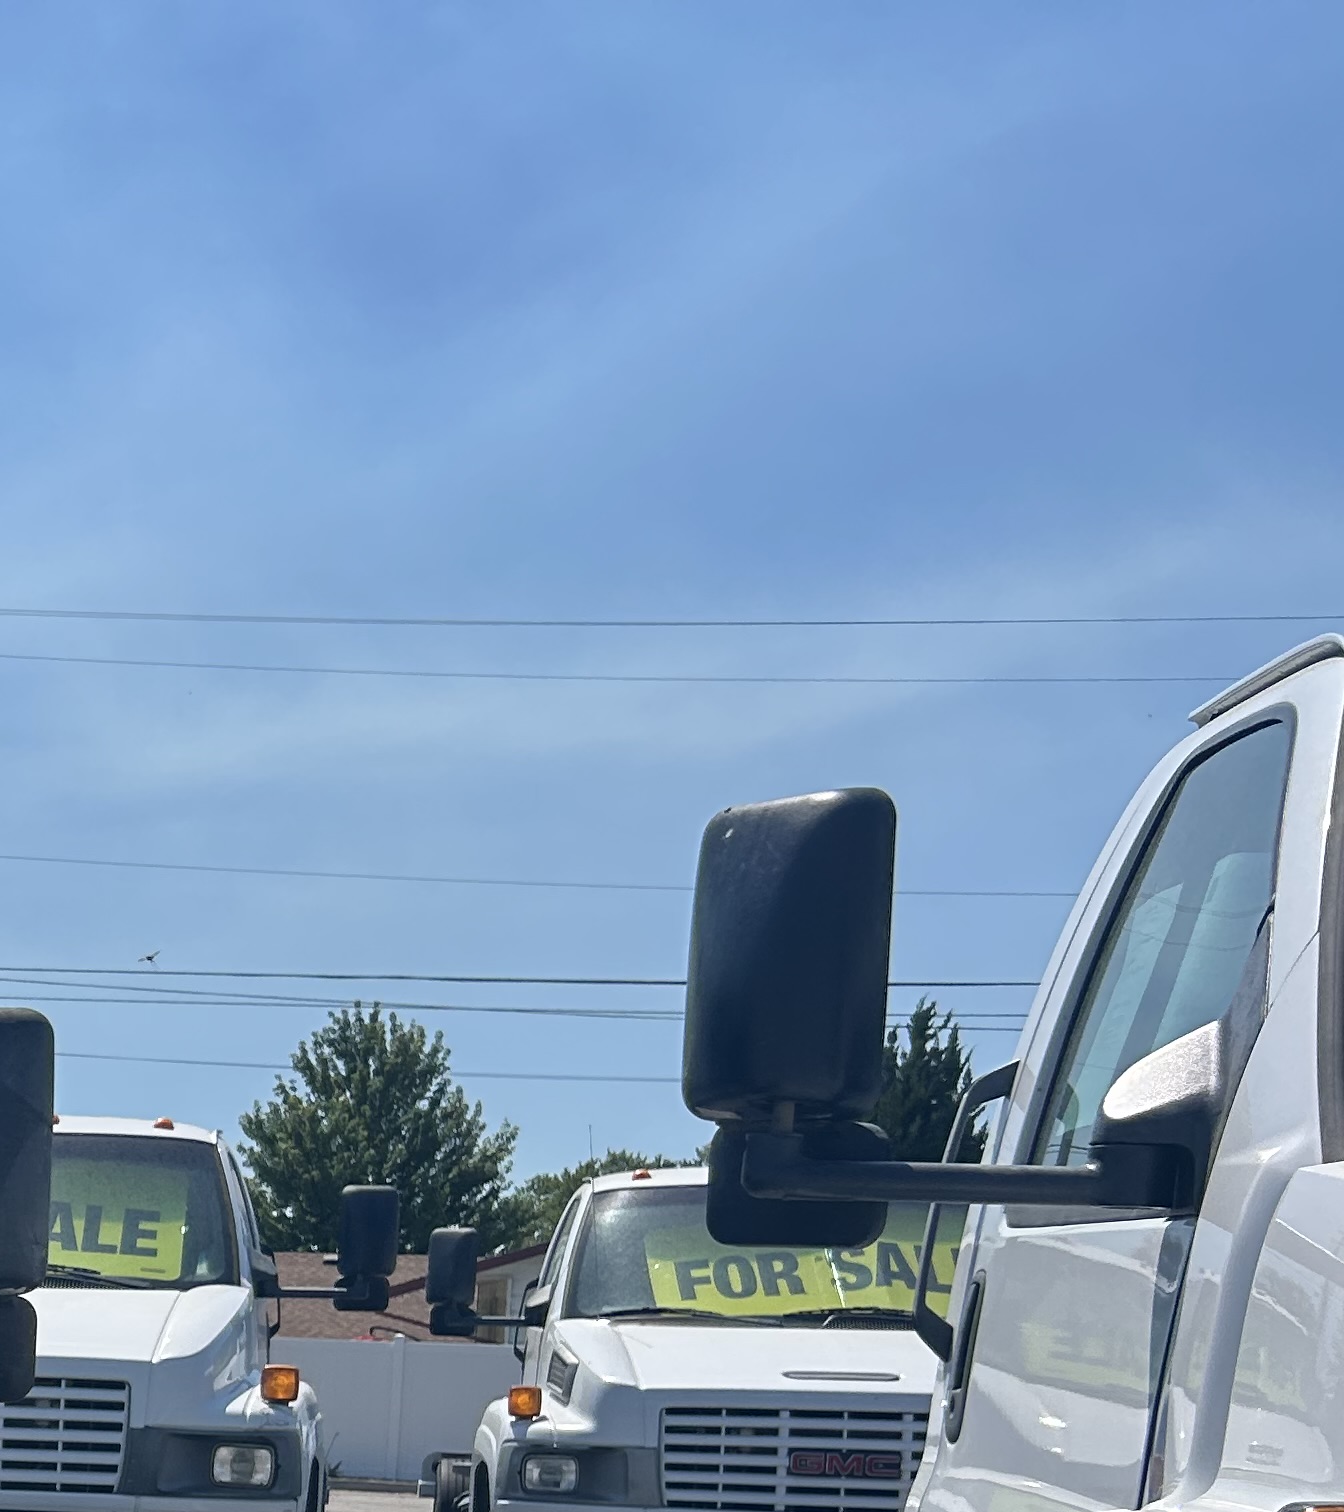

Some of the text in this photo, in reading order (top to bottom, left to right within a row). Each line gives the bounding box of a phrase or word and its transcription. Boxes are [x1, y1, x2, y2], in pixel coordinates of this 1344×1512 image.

[49, 1201, 161, 1257] ALE
[674, 1241, 958, 1300] FOR SAL
[790, 1451, 902, 1478] GMC
